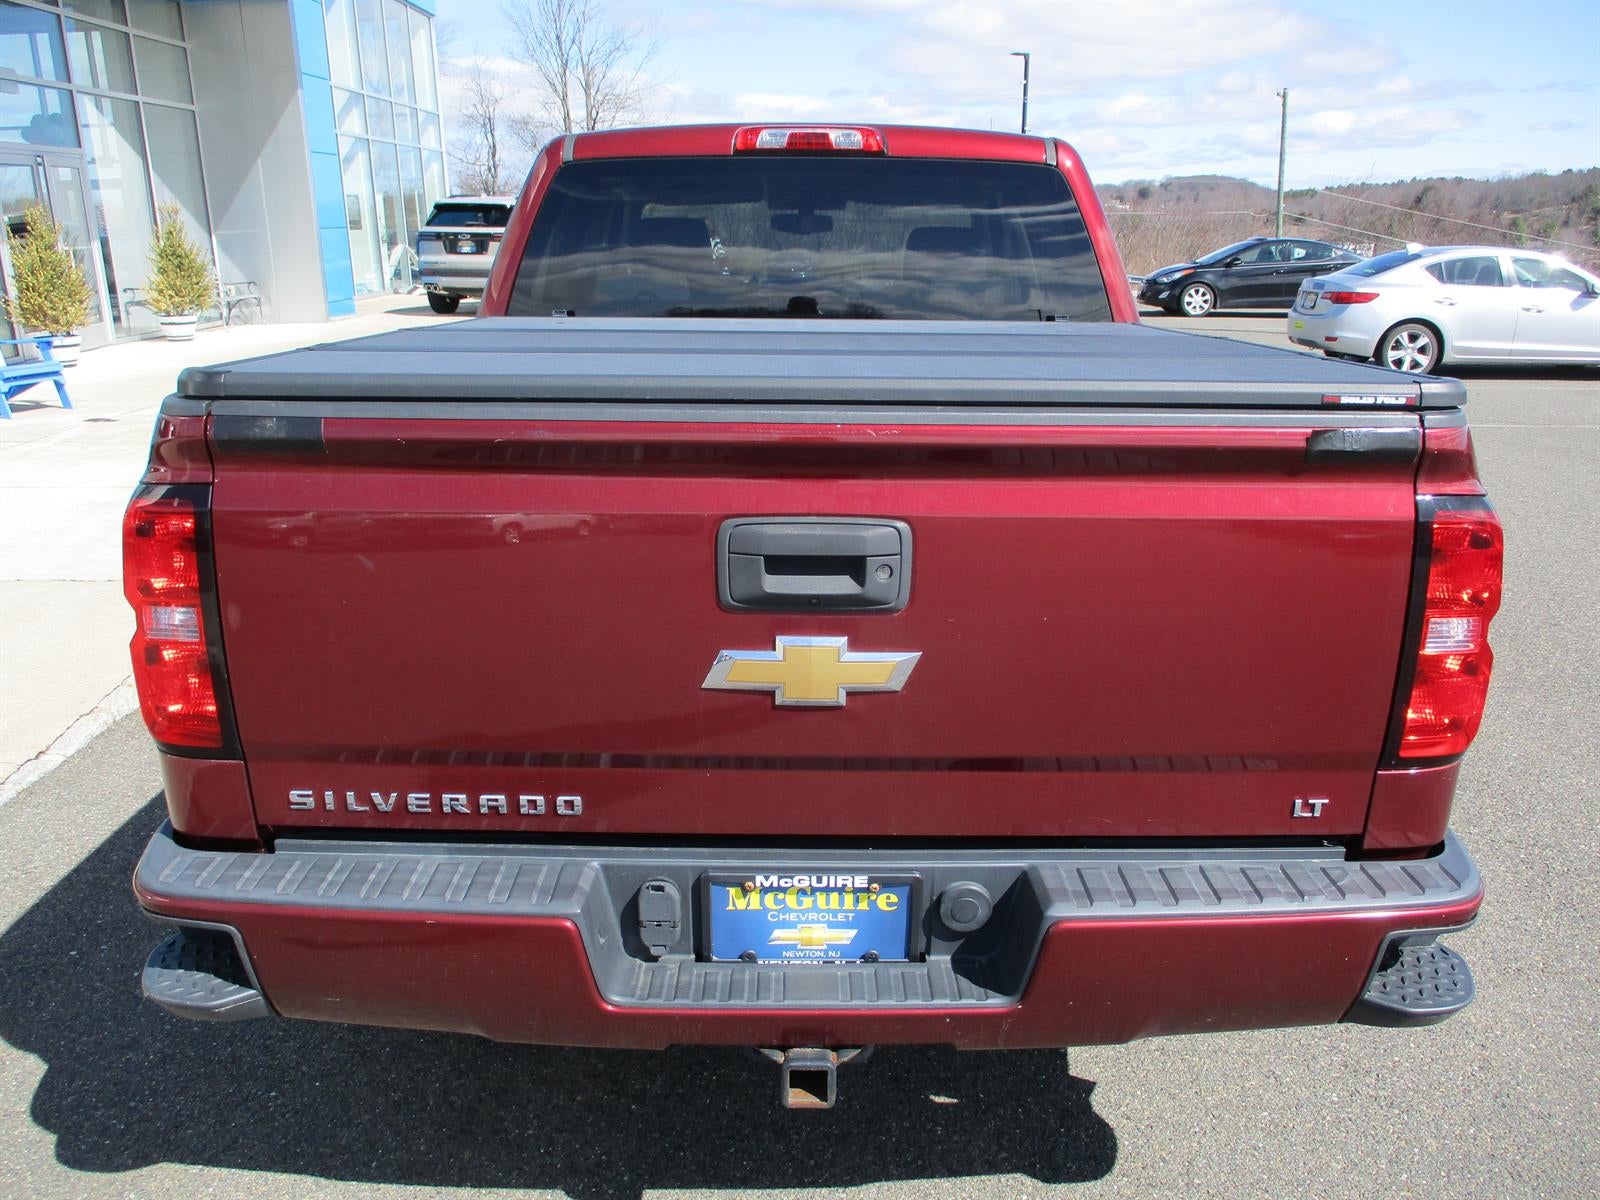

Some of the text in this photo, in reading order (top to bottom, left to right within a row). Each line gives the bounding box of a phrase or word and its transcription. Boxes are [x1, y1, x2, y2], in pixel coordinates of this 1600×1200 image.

[289, 790, 582, 816] SILVERADO
[1293, 799, 1329, 817] LT
[755, 875, 868, 887] McGUIRE
[726, 887, 898, 910] McGuire
[782, 950, 841, 958] NEWTON, NJ
